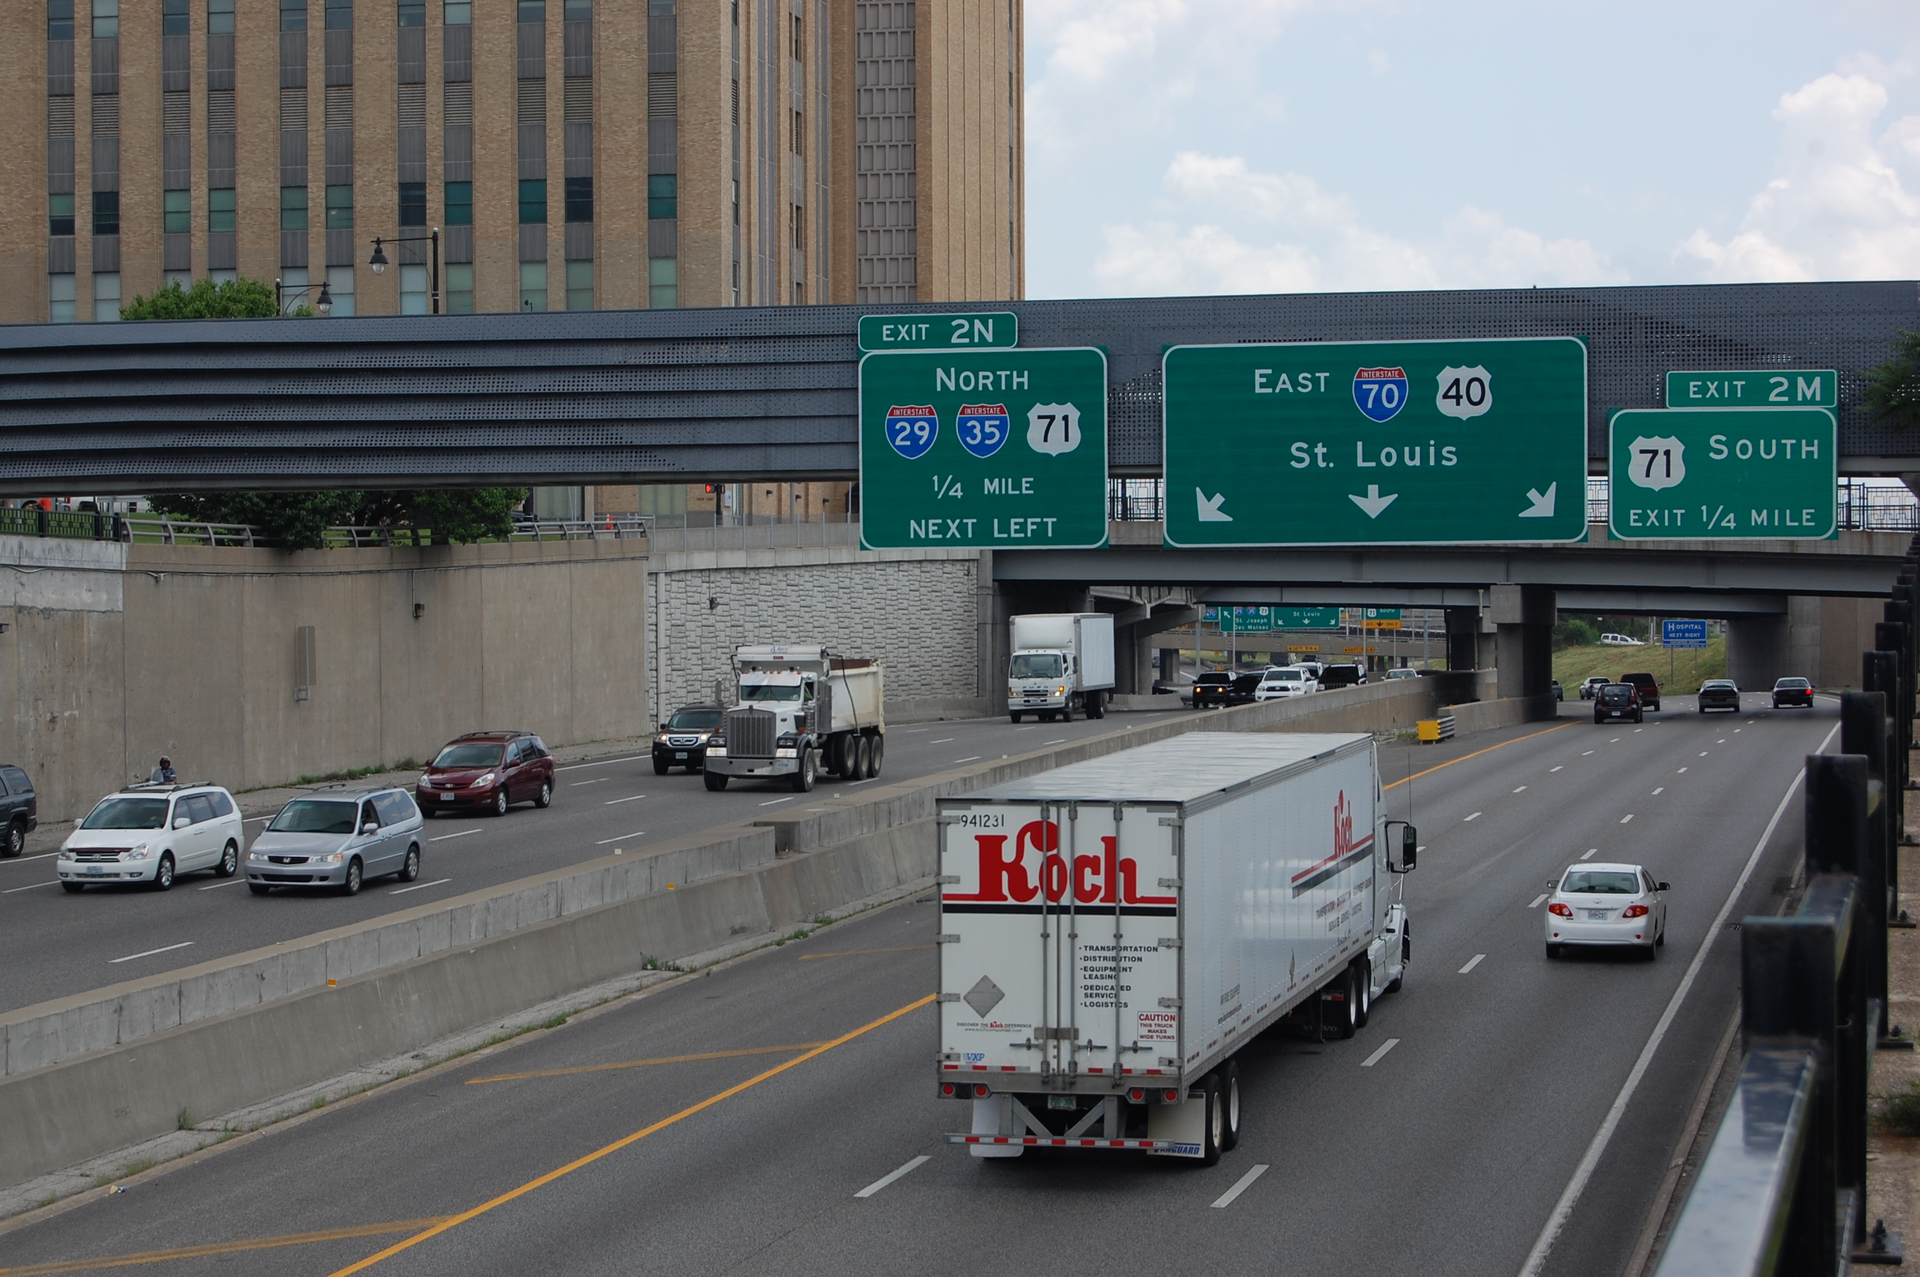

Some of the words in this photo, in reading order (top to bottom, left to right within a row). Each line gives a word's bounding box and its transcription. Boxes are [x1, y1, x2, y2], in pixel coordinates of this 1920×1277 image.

[882, 324, 929, 341] EXIT
[951, 319, 993, 343] 2N
[936, 368, 1029, 391] NORTH
[1254, 369, 1330, 393] EAST
[1361, 370, 1400, 379] INTERSTATE
[1361, 383, 1399, 410] 70
[1441, 376, 1486, 407] 40
[1689, 381, 1746, 398] EXIT
[1768, 376, 1821, 402] 2M
[893, 408, 930, 416] INTERSTATE
[964, 407, 1001, 415] INTERSTATE
[894, 421, 930, 446] 29
[966, 420, 1000, 445] 35
[1037, 414, 1070, 443] 71
[1289, 441, 1335, 469] St.
[1356, 440, 1458, 467] Louis
[1708, 434, 1819, 460] SOUTH
[1638, 449, 1671, 478] 71
[932, 475, 963, 499] 1/4
[984, 477, 1034, 495] MILE
[910, 519, 977, 539] NEXT
[993, 517, 1057, 538] LEFT
[1629, 509, 1685, 526] EXIT
[1701, 505, 1736, 530] 1/4
[1751, 509, 1816, 526] MILE
[1668, 623, 1702, 631] HOSPITAL
[960, 814, 1005, 828] 941231
[974, 820, 1142, 904] Koch
[1138, 1013, 1176, 1022] CAUTION
[966, 1053, 985, 1061] VXP
